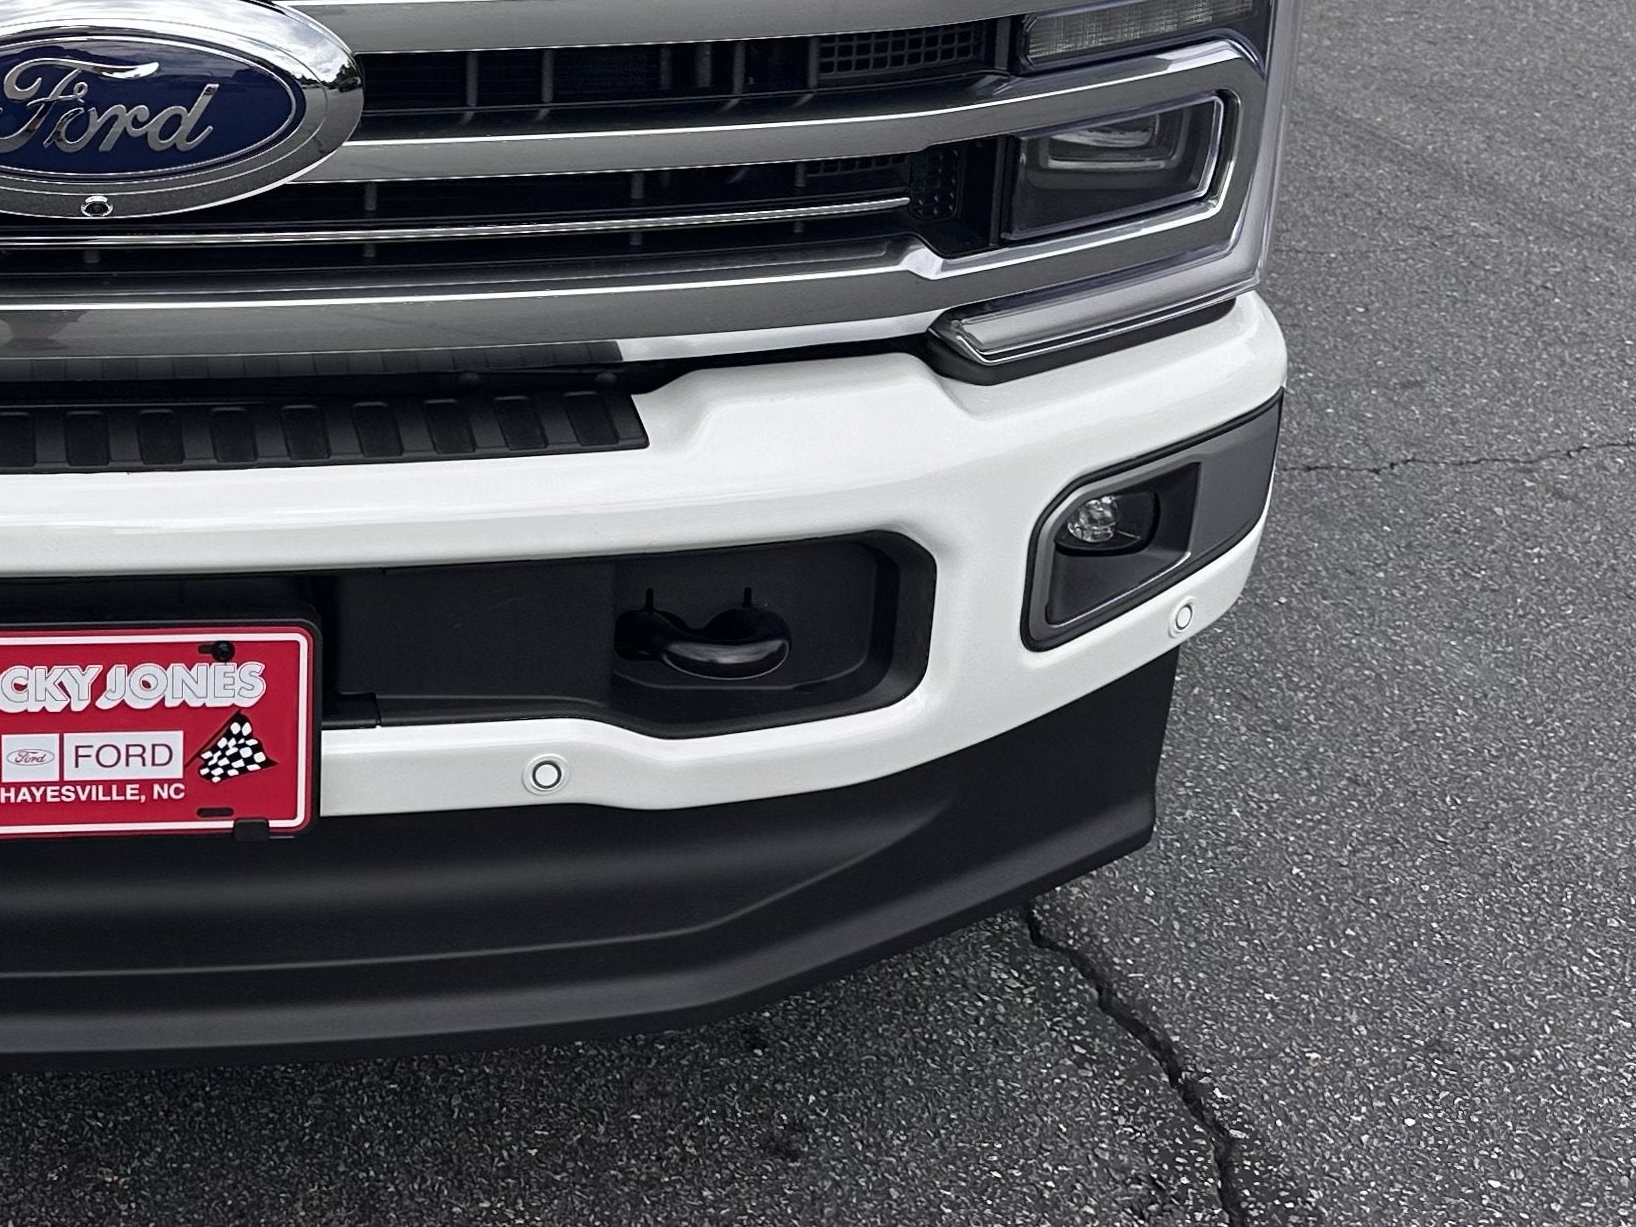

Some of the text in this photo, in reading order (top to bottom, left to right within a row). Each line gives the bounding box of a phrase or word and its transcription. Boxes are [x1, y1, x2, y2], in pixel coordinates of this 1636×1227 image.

[99, 661, 267, 711] JONES
[15, 750, 46, 764] Ford
[74, 743, 174, 769] FORD
[0, 783, 186, 804] HAYESVILLE, NC
